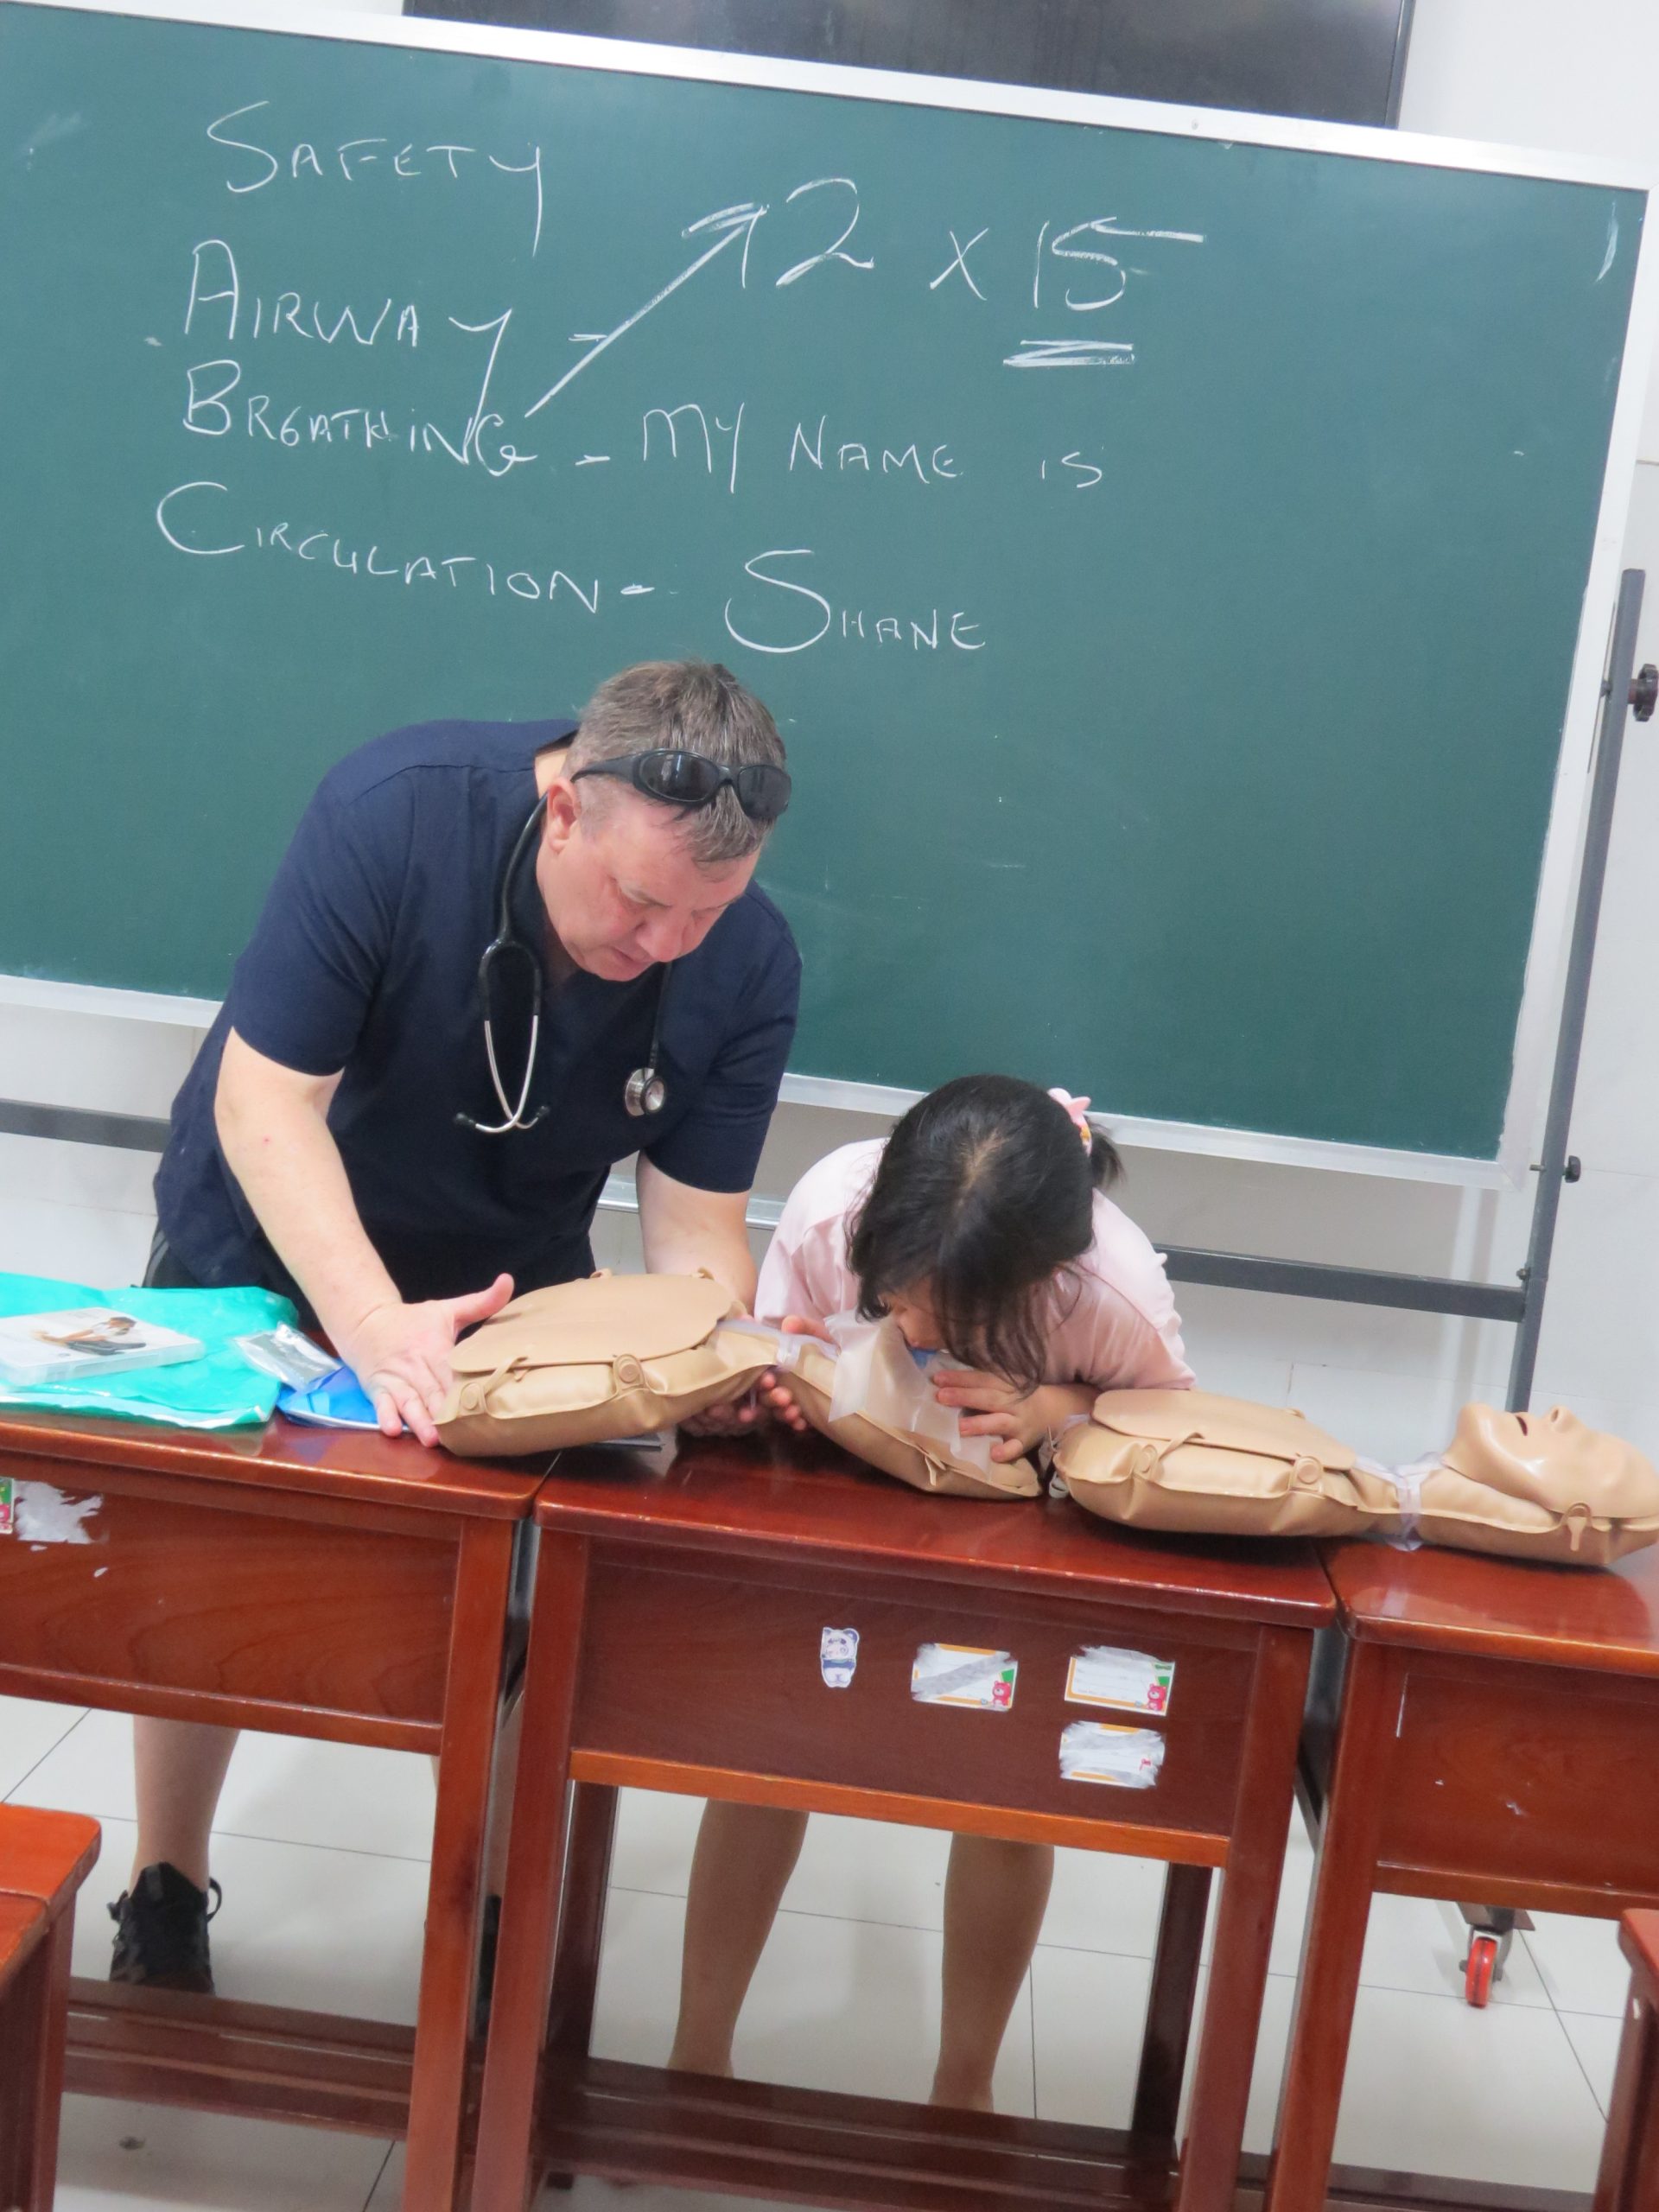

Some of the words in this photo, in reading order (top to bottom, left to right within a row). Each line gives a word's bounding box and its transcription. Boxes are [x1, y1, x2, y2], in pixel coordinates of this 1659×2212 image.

[206, 100, 543, 257] SAFETY
[777, 177, 875, 287] 2
[1034, 216, 1205, 311] 15
[184, 239, 513, 434] AIRWAY
[182, 359, 537, 477] BREATHING
[642, 402, 745, 493] MY
[789, 415, 963, 484] NAME
[156, 480, 600, 613] CIRCULATION
[724, 549, 986, 653] SHANE
